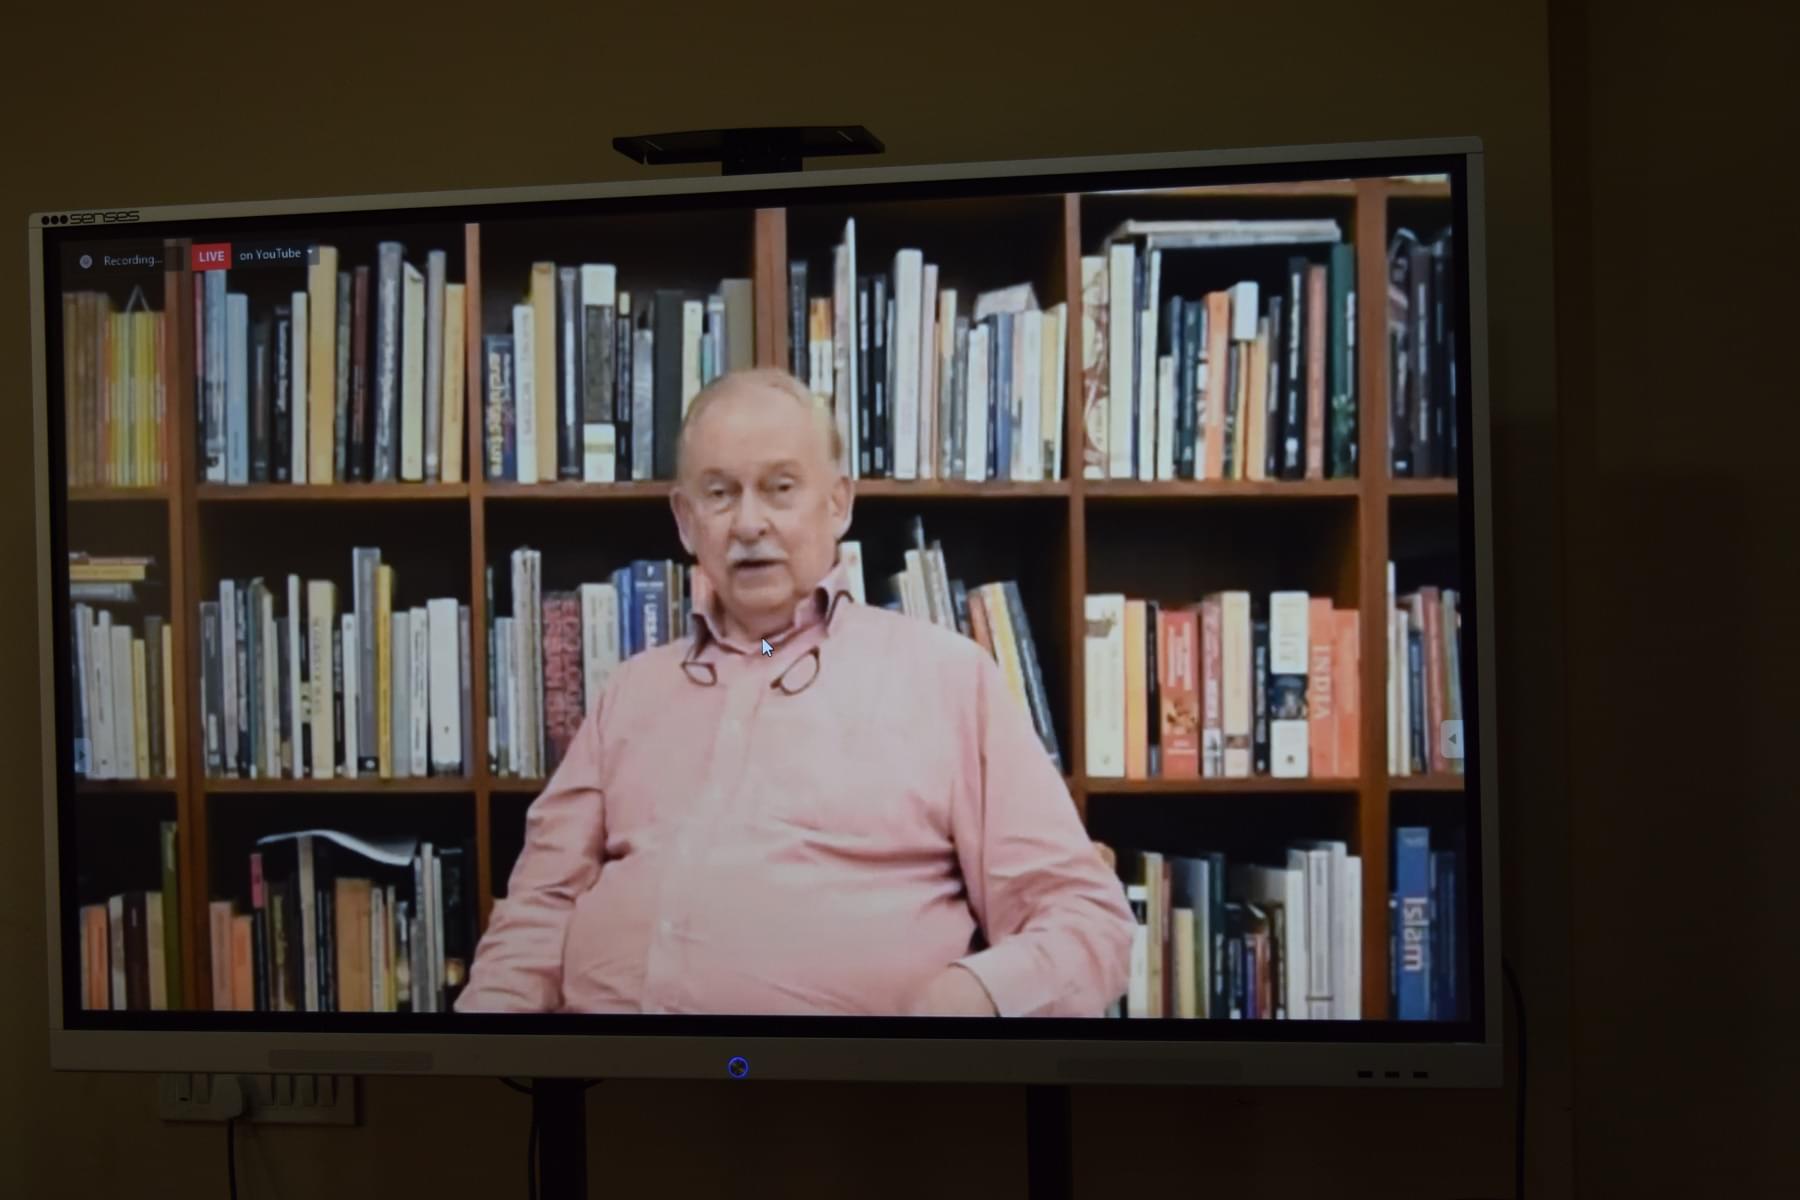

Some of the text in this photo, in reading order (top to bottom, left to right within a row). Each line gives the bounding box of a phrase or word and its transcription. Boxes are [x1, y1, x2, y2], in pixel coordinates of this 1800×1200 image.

[70, 211, 139, 225] senses
[200, 251, 225, 262] LIVE
[256, 248, 301, 260] YouTube
[1312, 643, 1331, 719] INDIA
[1402, 896, 1428, 971] Islam
